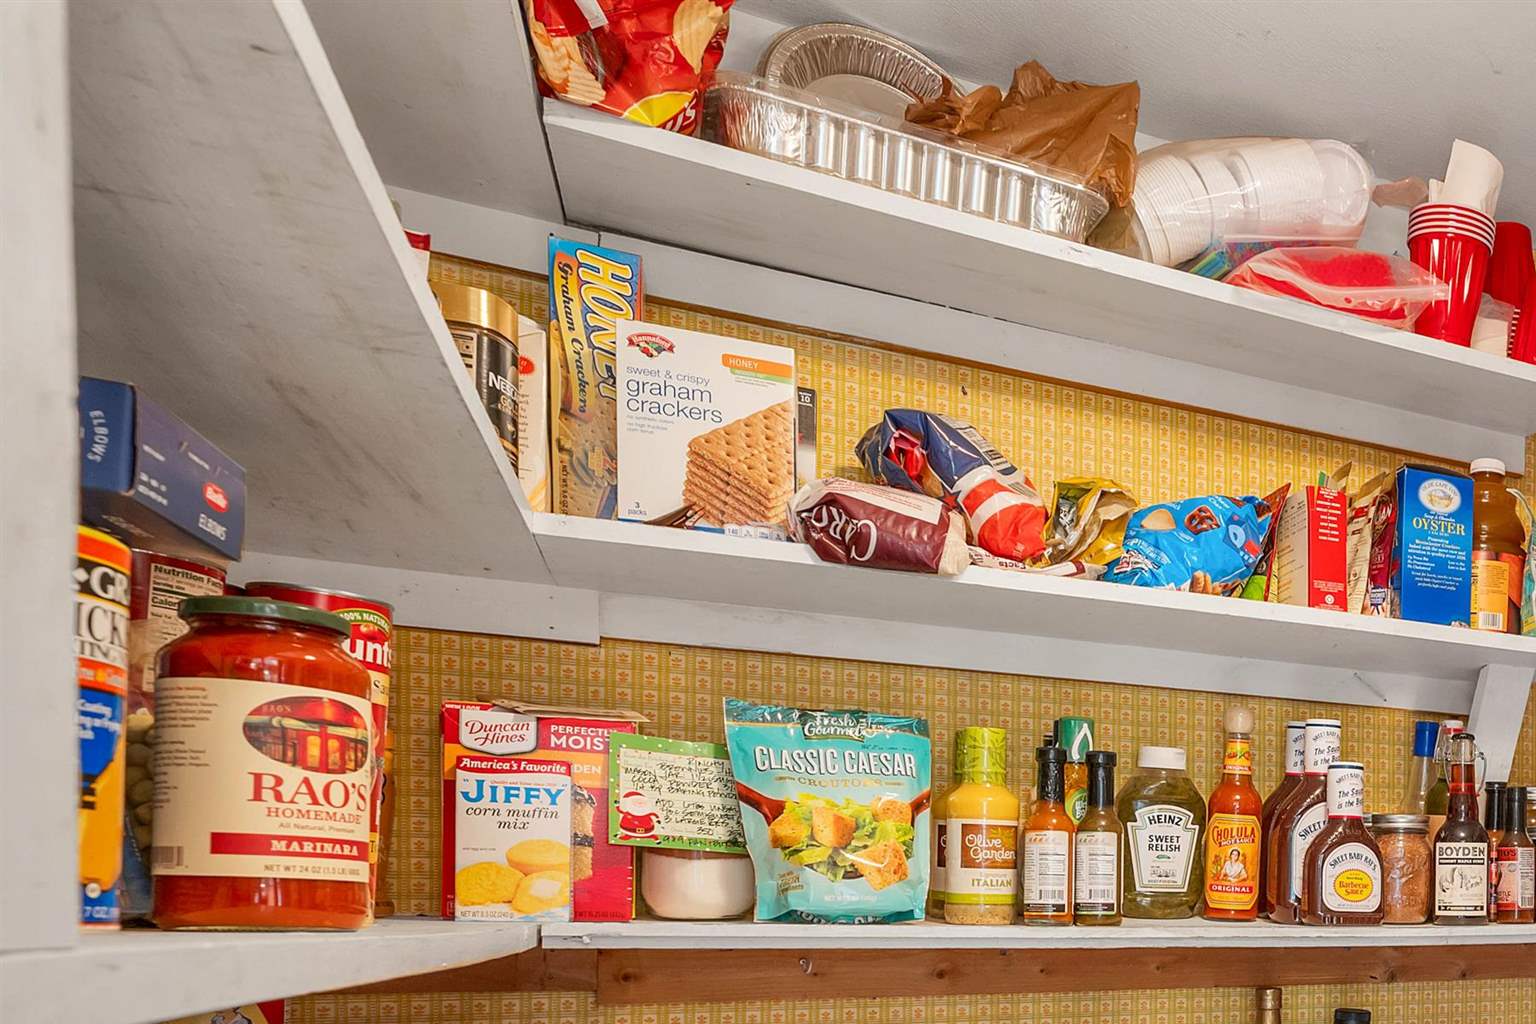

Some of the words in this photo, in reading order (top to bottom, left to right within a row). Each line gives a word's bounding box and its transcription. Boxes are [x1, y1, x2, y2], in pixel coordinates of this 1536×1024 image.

[629, 332, 673, 350] Hannaford
[729, 357, 758, 370] HONEY
[626, 365, 662, 379] sweet
[676, 371, 711, 388] crispy
[626, 377, 713, 403] graham
[626, 397, 723, 424] crackers
[87, 410, 109, 463] ELBOWS
[627, 508, 648, 518] packs
[1413, 517, 1465, 536] OYSTER
[153, 564, 205, 584] Nutrition
[465, 719, 530, 735] Duncan
[816, 713, 857, 727] Fresh
[475, 732, 526, 747] Hines
[1314, 747, 1325, 756] The
[460, 758, 517, 770] America's
[520, 761, 567, 774] Favorite
[755, 746, 839, 776] CLASSIC
[844, 749, 917, 779] CAESAR
[247, 772, 367, 812] RAO'S
[1338, 790, 1349, 799] The
[1344, 799, 1354, 808] the
[265, 807, 362, 825] HOMEMADE
[465, 806, 501, 817] corn
[507, 805, 559, 820] muffin
[497, 819, 529, 830] mix
[1148, 814, 1183, 828] HEINZ
[1211, 826, 1257, 844] CHOLULA
[1299, 821, 1322, 841] SWEET
[965, 834, 1002, 849] Olive
[1148, 834, 1181, 844] SWEET
[271, 839, 359, 856] MARINARA
[970, 844, 1017, 864] Garden
[1148, 843, 1181, 853] RELISH
[1438, 846, 1485, 857] BOYDEN
[1329, 852, 1348, 870] SWEET
[1349, 852, 1363, 861] BABY
[264, 864, 280, 873] NET
[283, 865, 296, 873] WT
[311, 865, 322, 874] OZ
[971, 879, 1012, 889] ITALIAN
[1211, 884, 1251, 894] ORIGINAL
[1339, 880, 1369, 890] Barbecue
